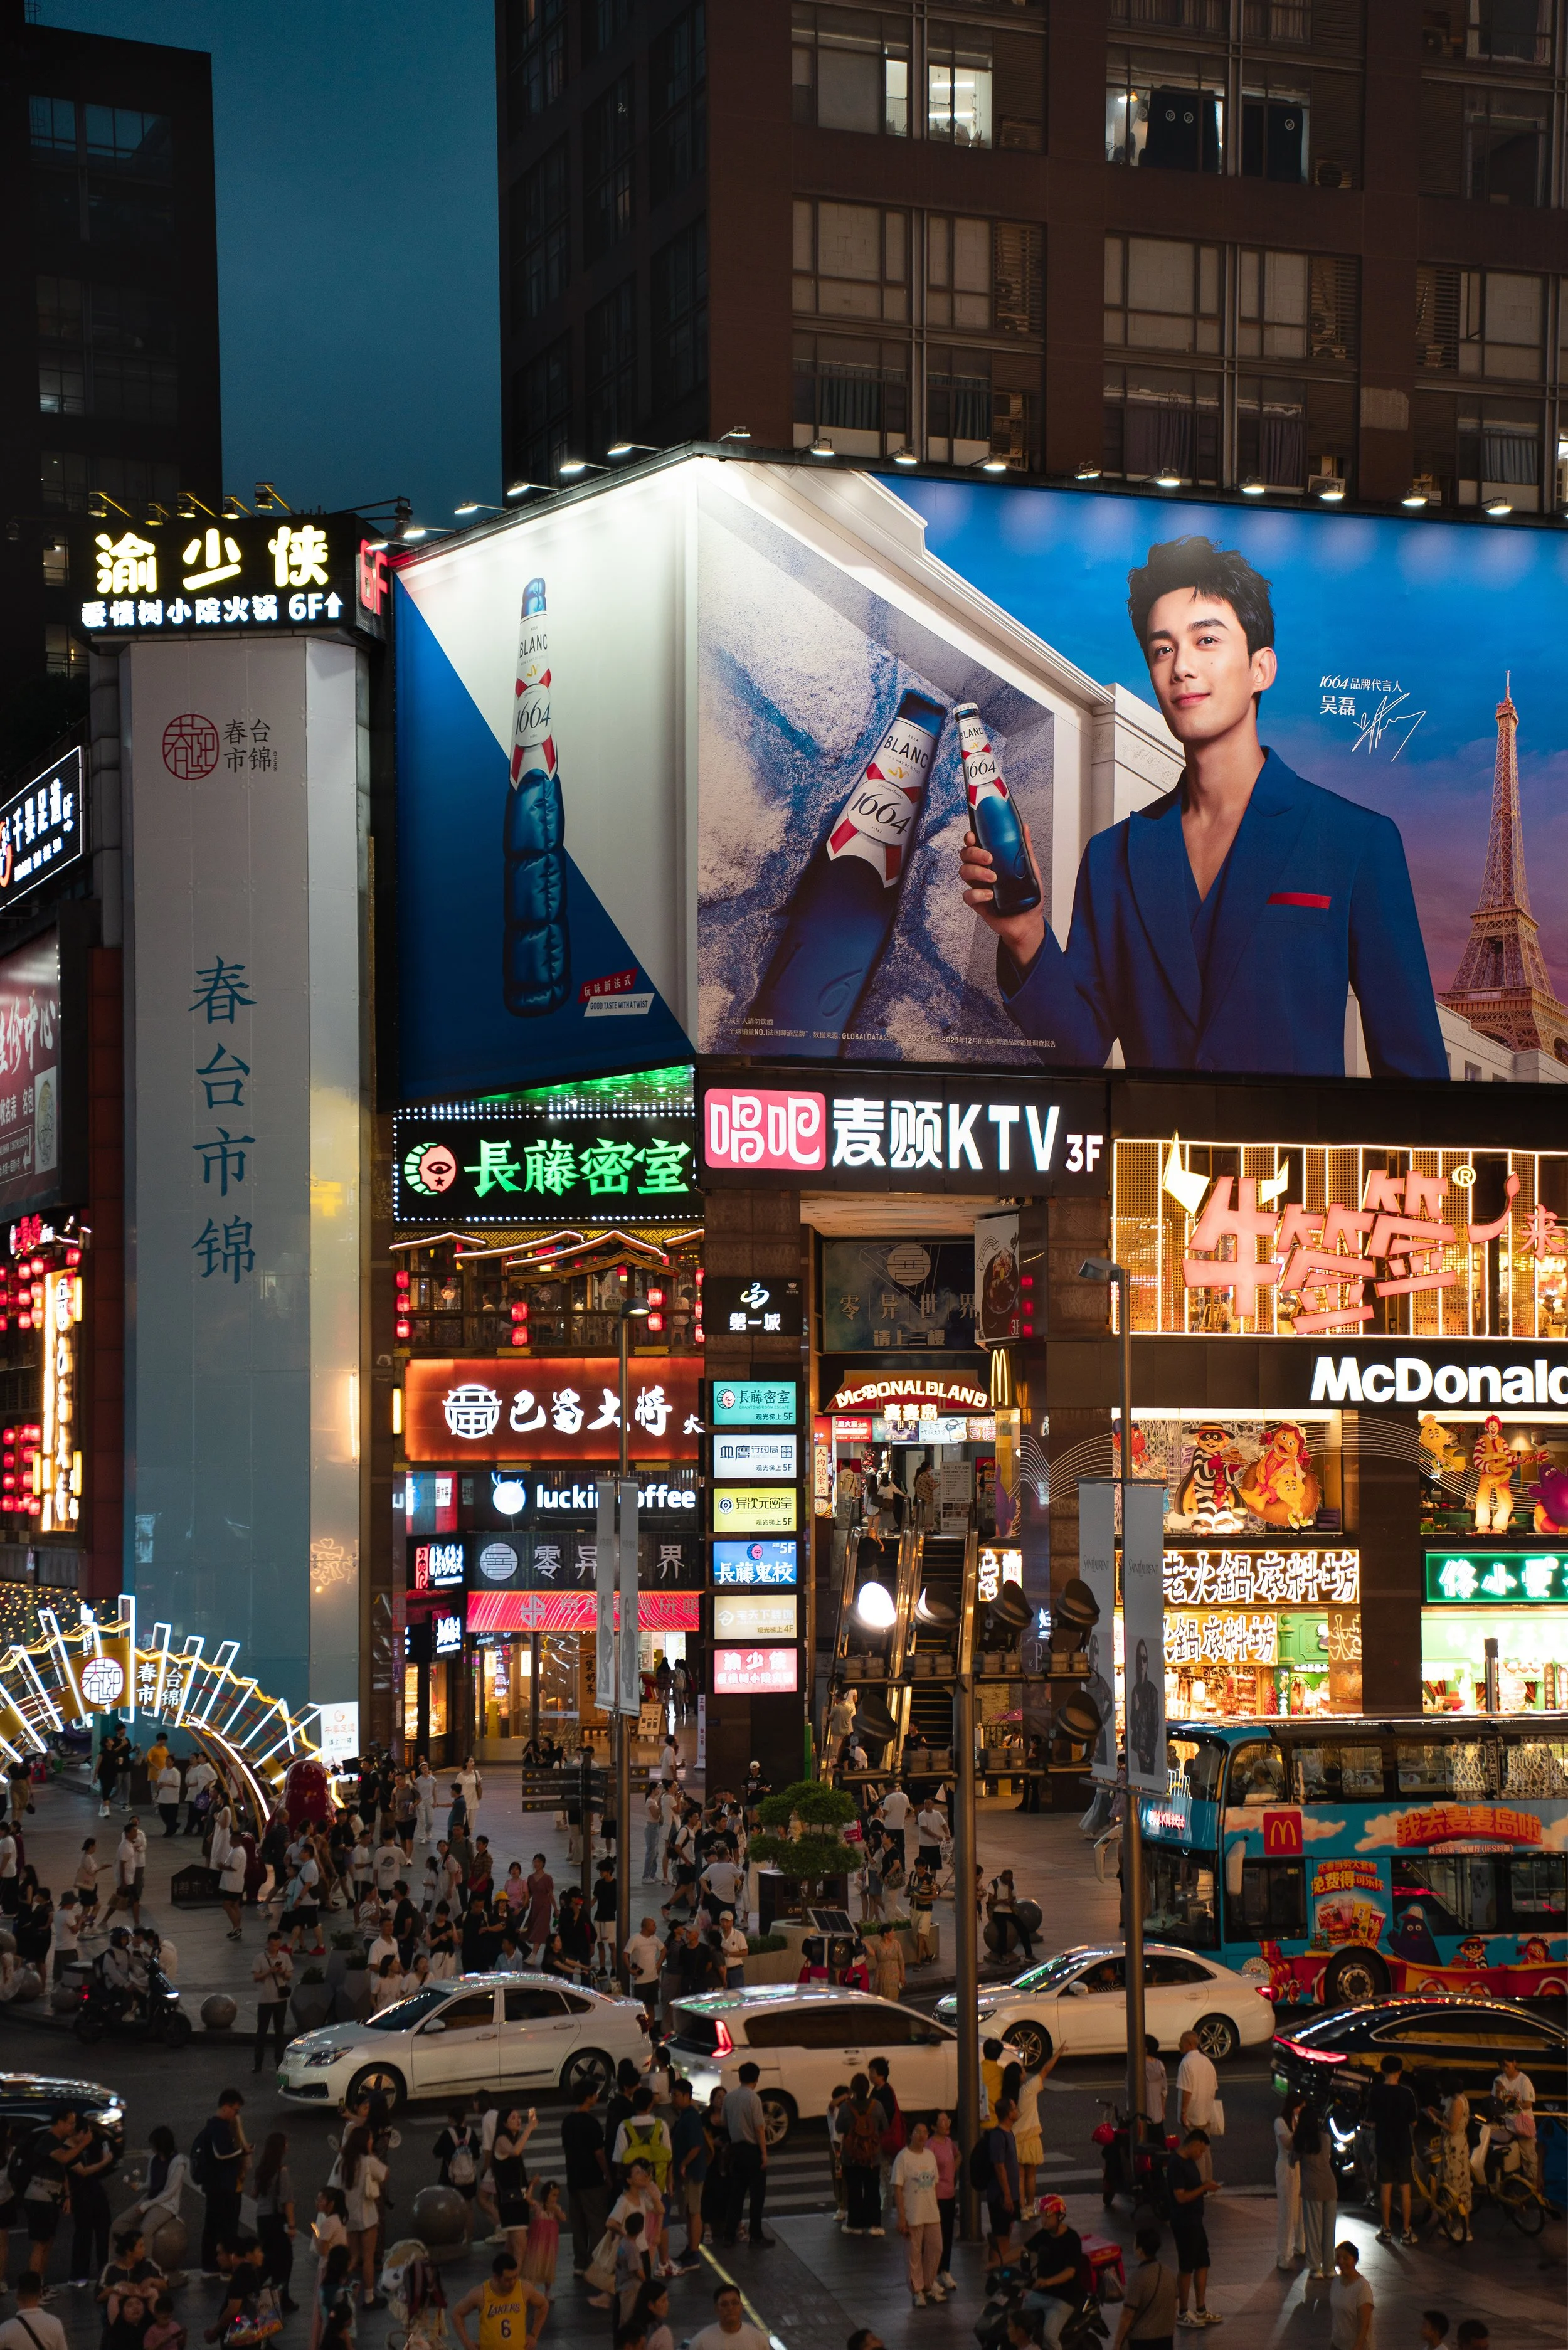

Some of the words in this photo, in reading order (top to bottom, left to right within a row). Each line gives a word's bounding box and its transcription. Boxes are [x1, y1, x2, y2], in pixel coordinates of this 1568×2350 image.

[95, 524, 329, 594] 渝少侠
[81, 595, 278, 628] 爱情树小院火锅
[519, 633, 548, 659] BLANC
[515, 697, 551, 736] 1664
[1320, 695, 1355, 716] 吴磊
[960, 727, 984, 740] BLANC
[883, 736, 928, 769] BLANC
[967, 758, 997, 780] 1664
[850, 792, 911, 835] 1664
[584, 974, 632, 997] 玩味新法式
[603, 1002, 617, 1010] TASTE
[618, 1001, 629, 1009] WITH
[723, 1017, 773, 1026] 未成年人请勿饮酒
[188, 955, 258, 1284] 春台市锦
[710, 1096, 821, 1163] 唱吧
[1066, 1134, 1104, 1172] 3F
[729, 1313, 781, 1331] 第一城
[873, 1329, 946, 1347] 请上三楼
[509, 1384, 674, 1437] 巴蜀大将
[783, 1412, 793, 1421] 5F
[884, 1403, 938, 1421] 麦麦岛
[816, 1449, 827, 1494] 人均50余元
[537, 1485, 597, 1508] lucki
[736, 1497, 792, 1510] 异次元密室
[780, 1543, 795, 1554] 5F
[533, 1545, 685, 1580] 零异界
[1397, 1804, 1543, 1845] 我去麦麦岛啦
[487, 2302, 521, 2318] LAKERS
[501, 2318, 511, 2339] 6
